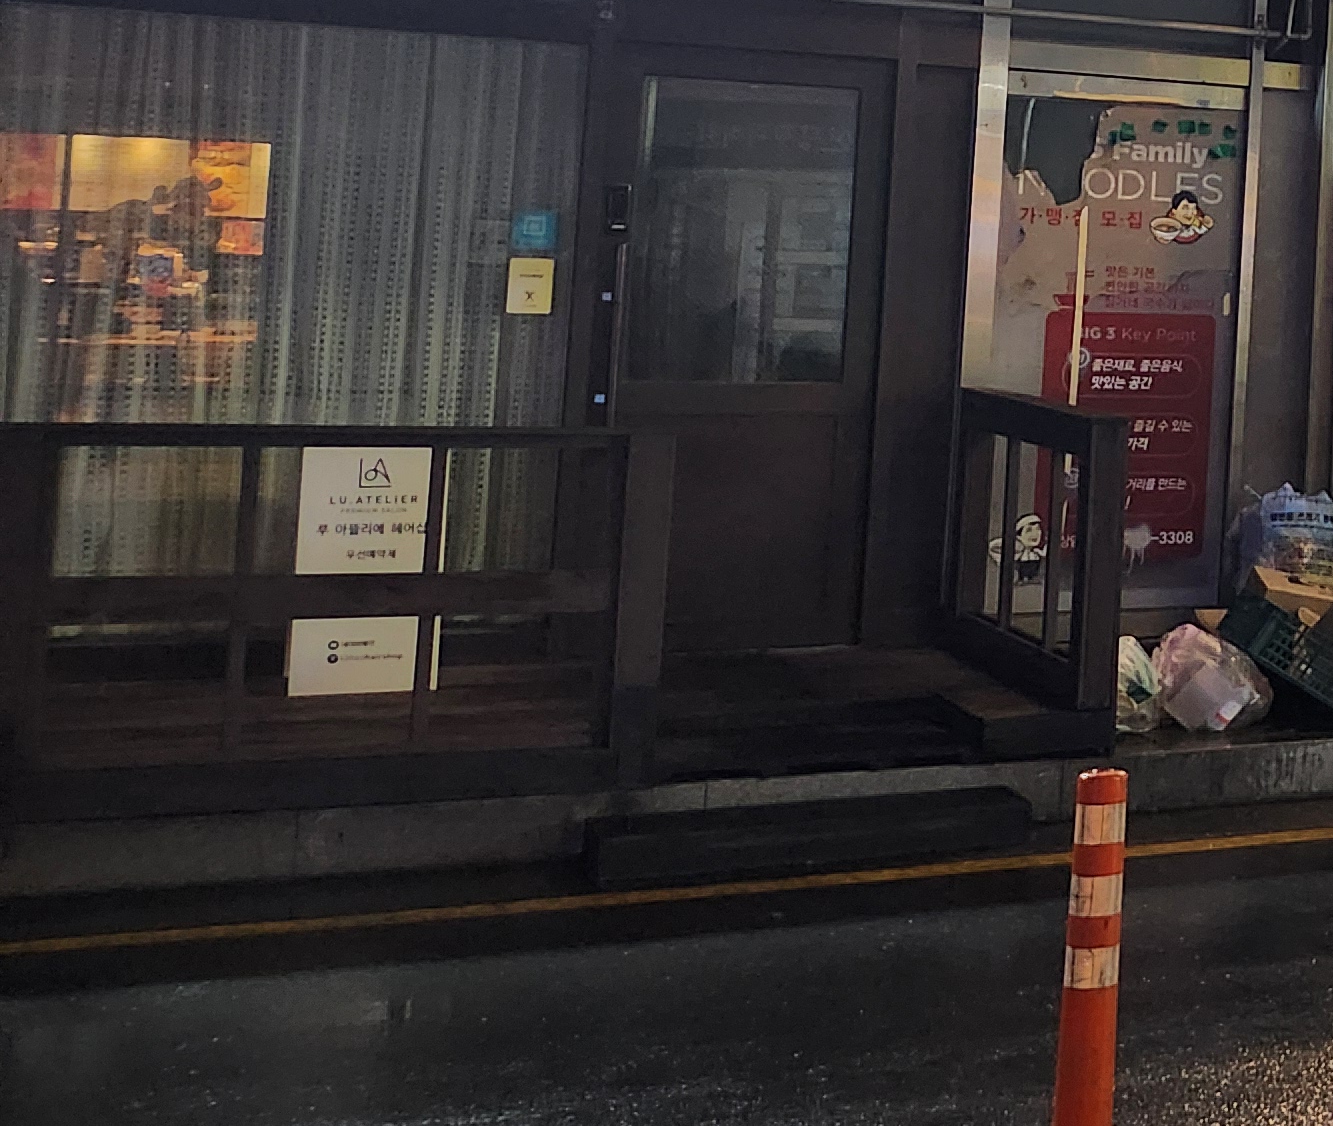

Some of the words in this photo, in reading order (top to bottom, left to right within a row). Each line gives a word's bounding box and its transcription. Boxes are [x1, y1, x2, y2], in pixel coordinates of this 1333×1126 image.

[1112, 140, 1209, 168] Family
[1015, 167, 1224, 205] NODLES
[1105, 327, 1117, 340] 3
[1121, 327, 1151, 343] Key
[1091, 375, 1127, 390] 맛있는
[1128, 376, 1153, 390] 공간
[1157, 419, 1169, 433] 수
[1171, 419, 1194, 433] 있는
